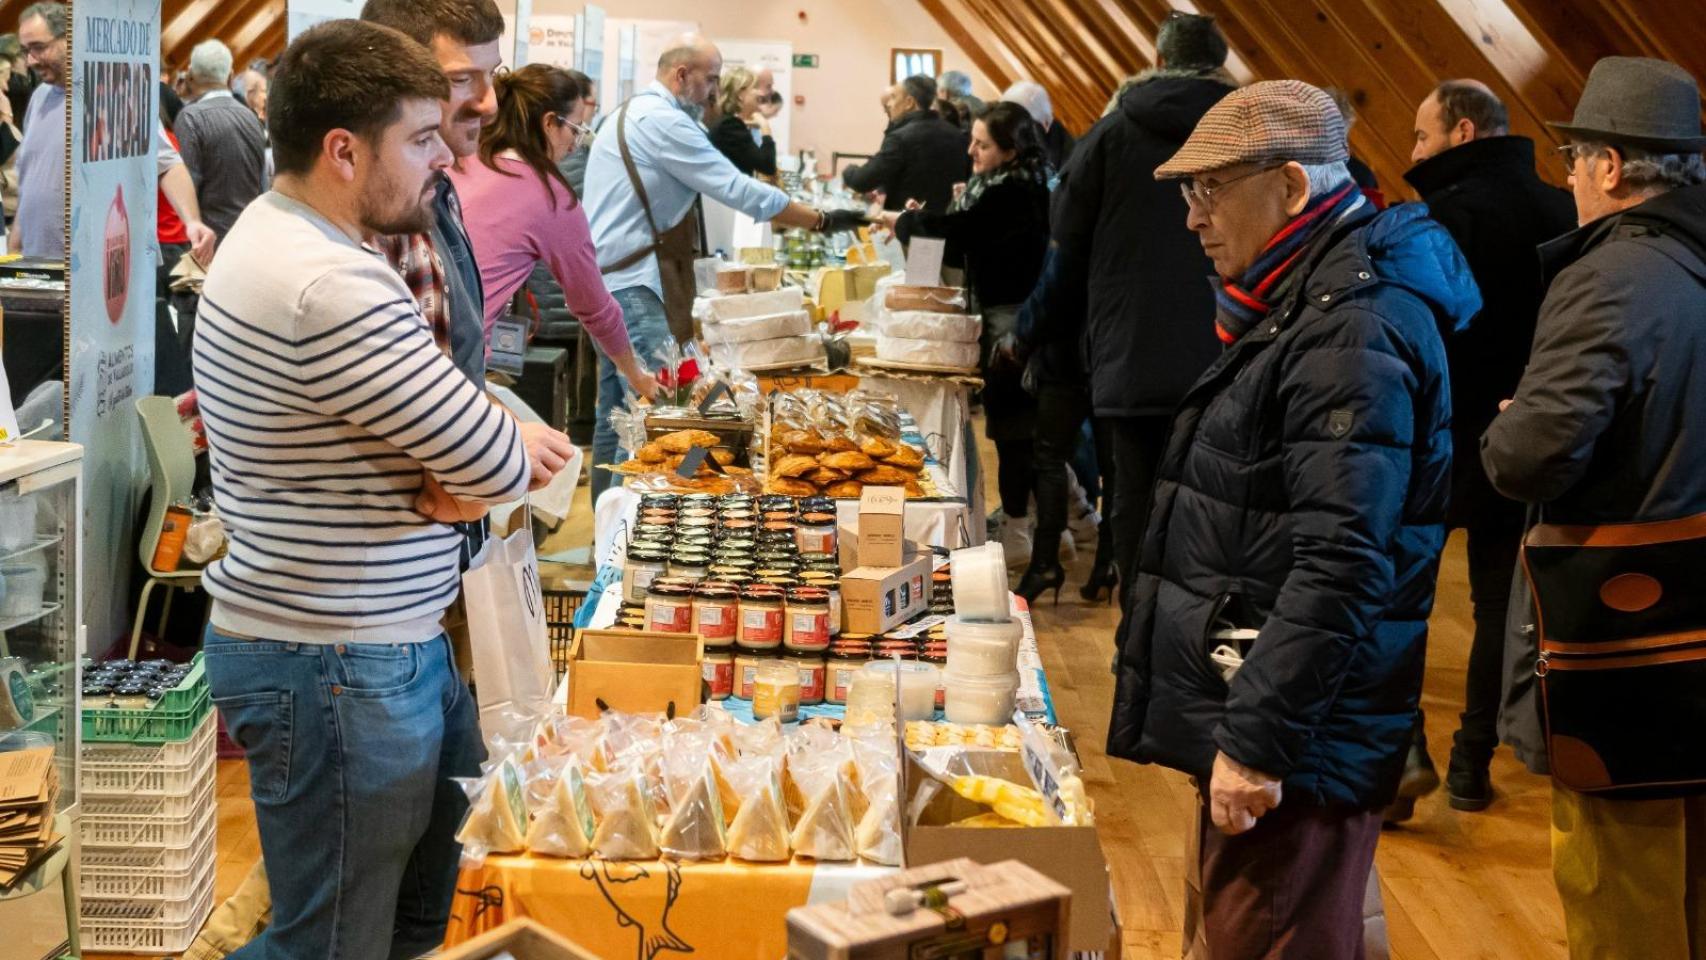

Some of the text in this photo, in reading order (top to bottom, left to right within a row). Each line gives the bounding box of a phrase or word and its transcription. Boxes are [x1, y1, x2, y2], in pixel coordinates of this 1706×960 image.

[86, 16, 150, 56] MERCADO DE
[83, 60, 151, 163] NAVIDAD
